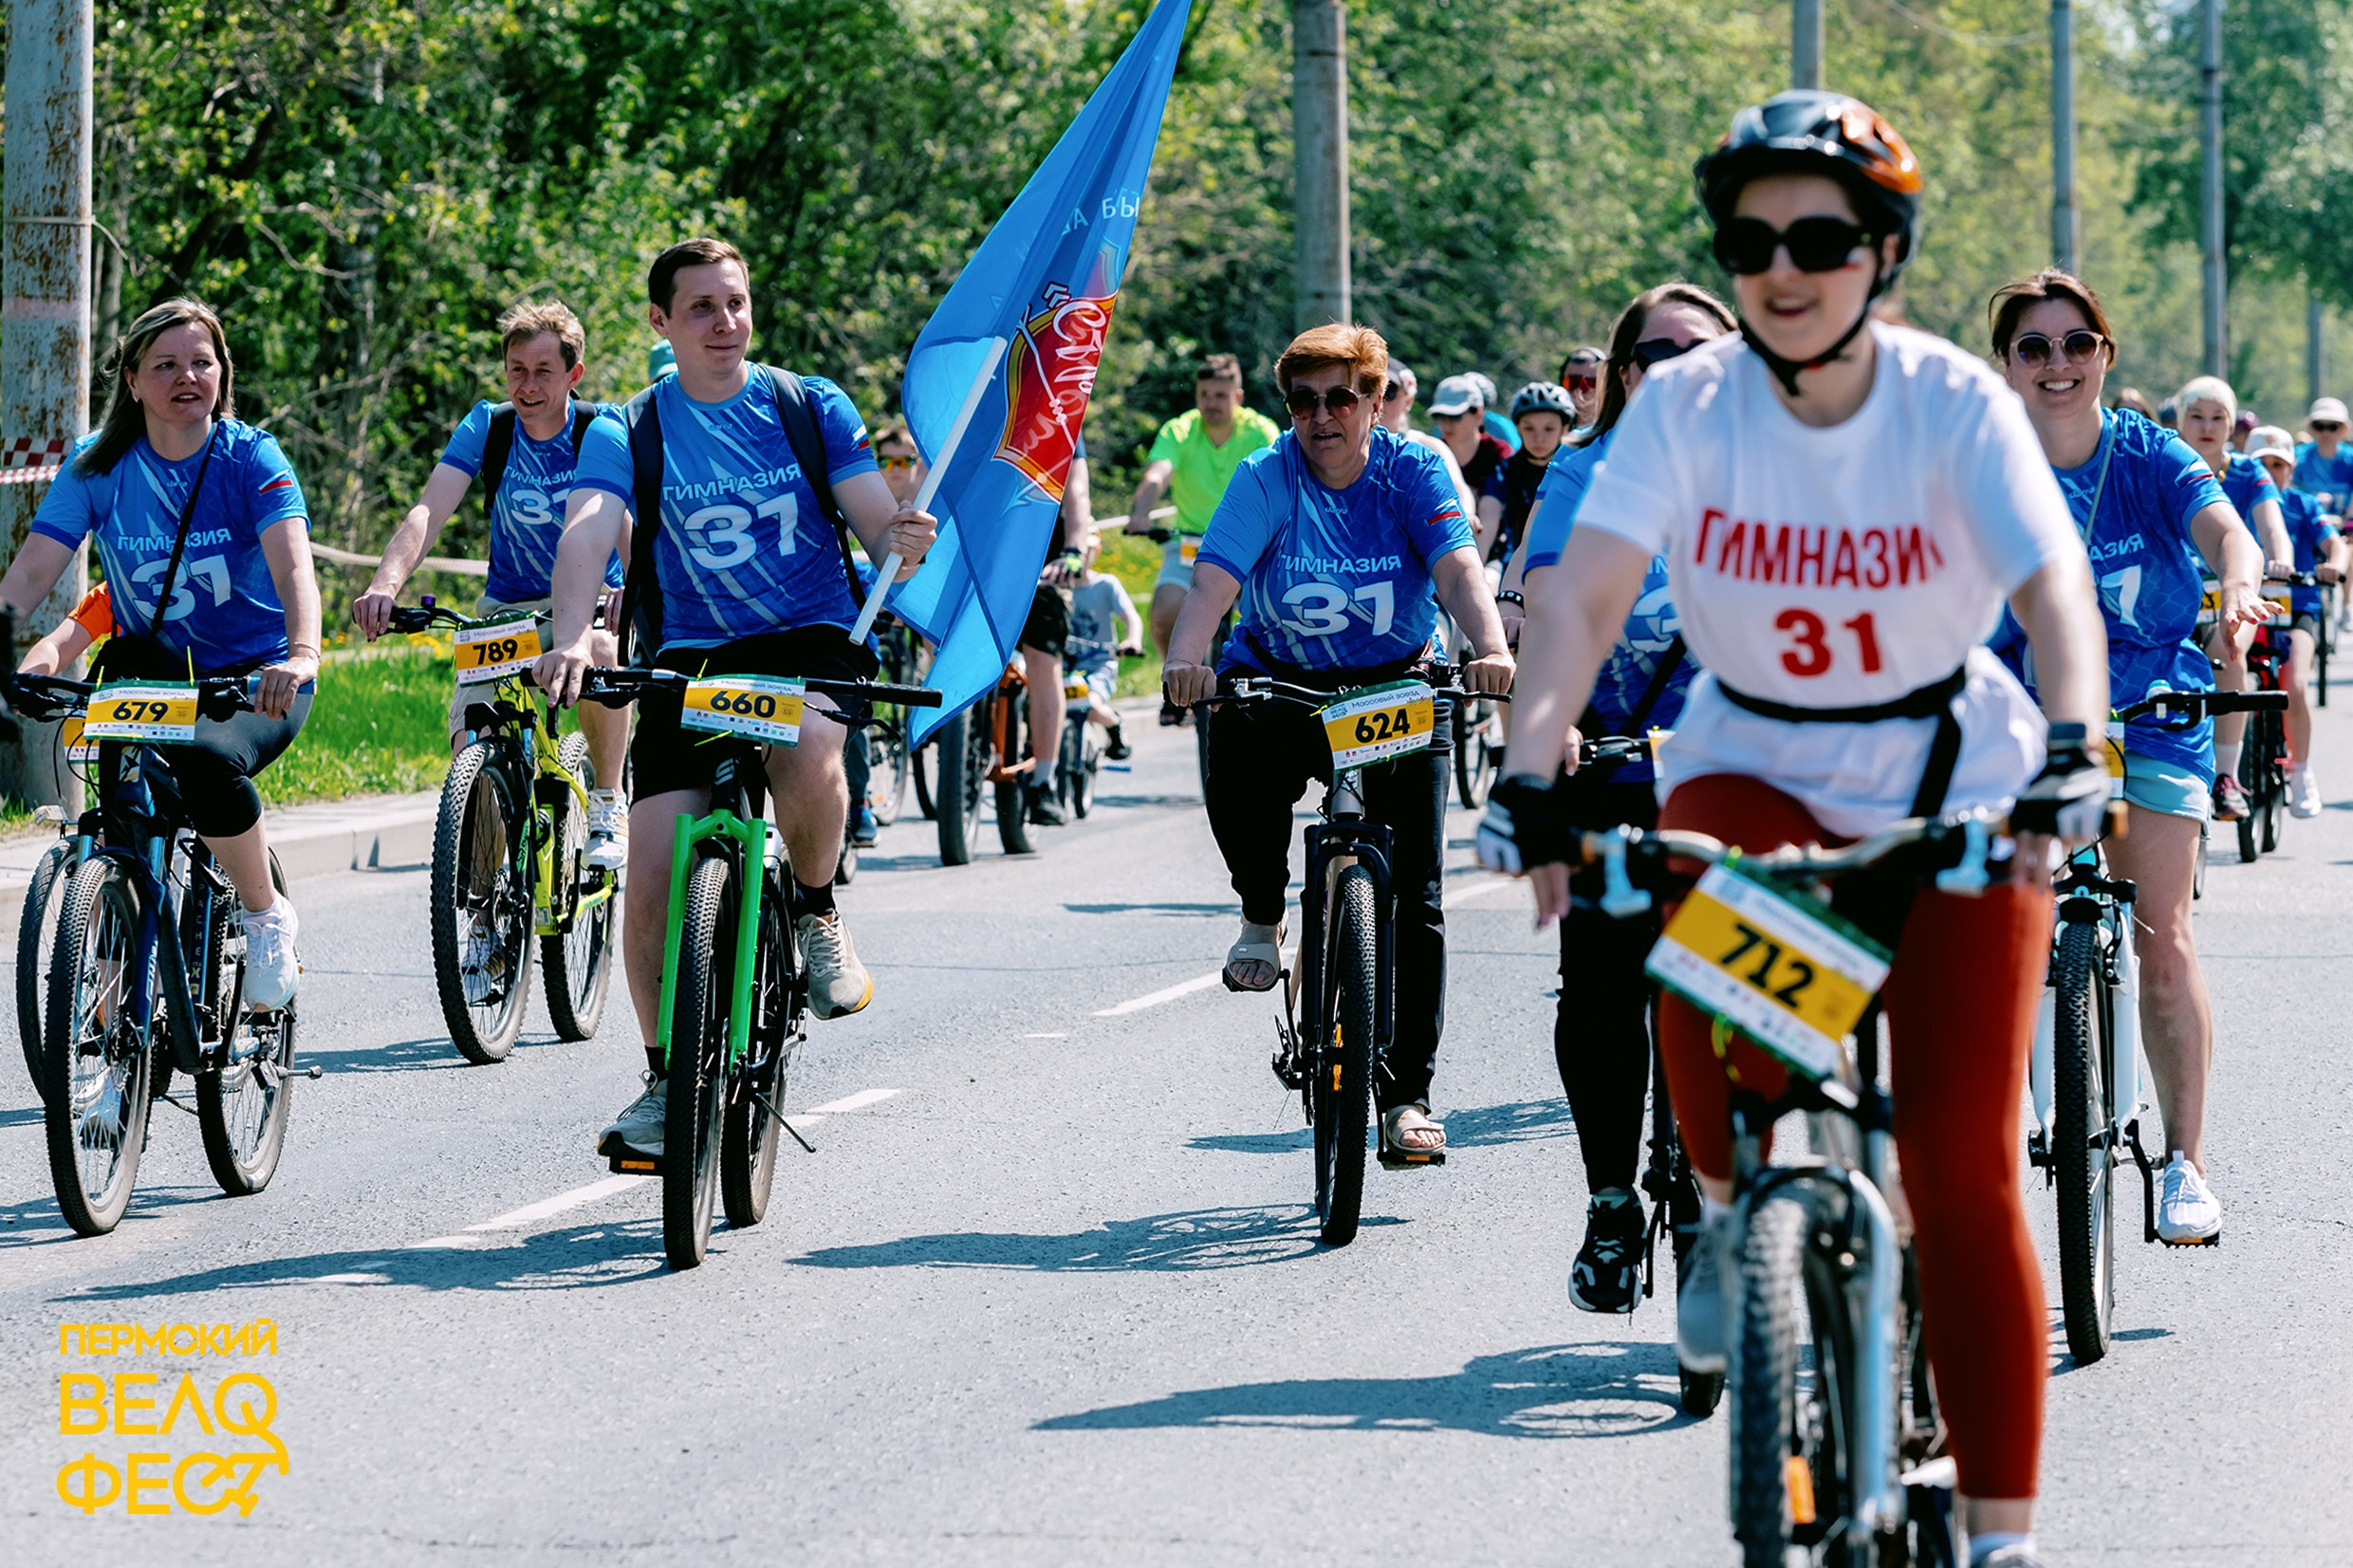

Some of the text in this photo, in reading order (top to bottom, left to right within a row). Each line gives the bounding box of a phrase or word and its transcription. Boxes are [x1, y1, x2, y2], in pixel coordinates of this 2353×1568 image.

[502, 465, 577, 487] ГИМНАЗИ
[662, 462, 803, 502] ГИМНАЗИЯ
[683, 491, 799, 570] 31
[2089, 532, 2145, 562] АЗИЯ
[131, 554, 232, 621] 31
[2100, 563, 2142, 629] 1
[1281, 580, 1395, 637] 31
[472, 638, 518, 665] 789
[1774, 608, 1881, 676] 31
[112, 701, 169, 722] 679
[710, 690, 777, 719] 660
[1355, 708, 1411, 744] 624
[1720, 921, 1815, 1009] 712
